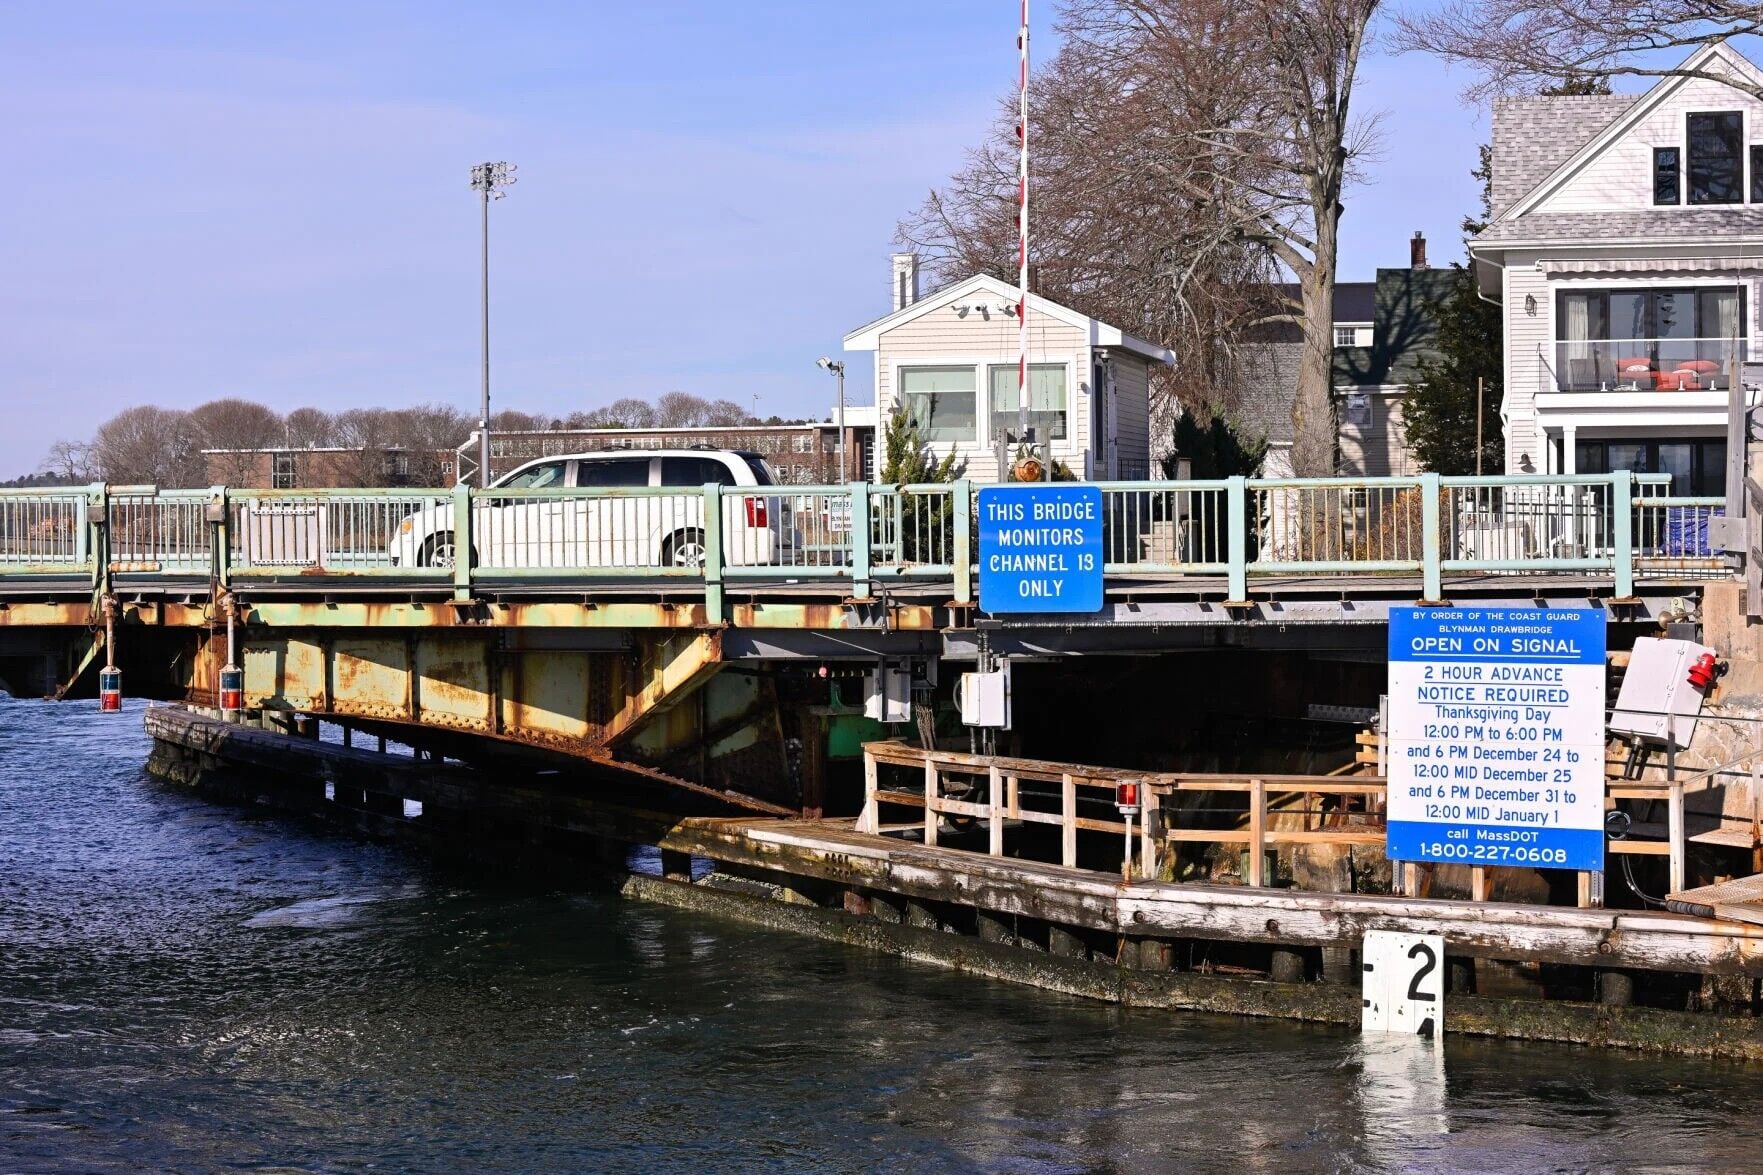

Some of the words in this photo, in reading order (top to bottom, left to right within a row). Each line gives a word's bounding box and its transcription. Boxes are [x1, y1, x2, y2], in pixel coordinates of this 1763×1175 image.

[988, 504, 1024, 520] THIS
[1034, 502, 1094, 520] BRIDGE
[999, 528, 1084, 546] MONITORS
[990, 554, 1068, 572] CHANNEL
[1078, 554, 1094, 571] 13
[1020, 580, 1063, 597] ONLY
[1412, 637, 1462, 651] OPEN
[1473, 638, 1500, 652] ON
[1512, 639, 1581, 653] SIGNAL
[1424, 666, 1433, 679] 2
[1442, 666, 1482, 680] HOUR
[1491, 667, 1563, 681] ADVANCE
[1418, 687, 1475, 700] NOTICE
[1485, 688, 1568, 702] REQUIRED
[1435, 705, 1518, 724] Thanksgiving
[1526, 708, 1551, 724] Day
[1424, 725, 1459, 738] 12:00
[1465, 726, 1483, 739] PM
[1488, 727, 1500, 740] to
[1506, 728, 1537, 740] 6:00
[1543, 728, 1562, 741] PM
[1407, 745, 1430, 757] and
[1436, 746, 1444, 758] 6
[1450, 746, 1468, 758] PM
[1474, 746, 1538, 760] December
[1543, 748, 1561, 762] 24
[1567, 750, 1579, 762] to
[1414, 764, 1448, 778] 12:00
[1454, 766, 1477, 779] MID
[1484, 767, 1548, 781] December
[1553, 769, 1572, 782] 25
[1409, 785, 1431, 797] and
[1437, 785, 1445, 798] 6
[1451, 786, 1469, 799] PM
[1476, 787, 1539, 801] December
[1545, 789, 1558, 802] 31
[1564, 790, 1576, 803] to
[1426, 805, 1460, 818] 12:00
[1466, 806, 1489, 819] MID
[1495, 808, 1549, 825] January
[1554, 810, 1558, 823] 1
[1447, 829, 1468, 839] call
[1477, 830, 1539, 842] MassDOT
[1420, 843, 1567, 863] 1-800-227-0608
[1408, 943, 1436, 1001] 2
